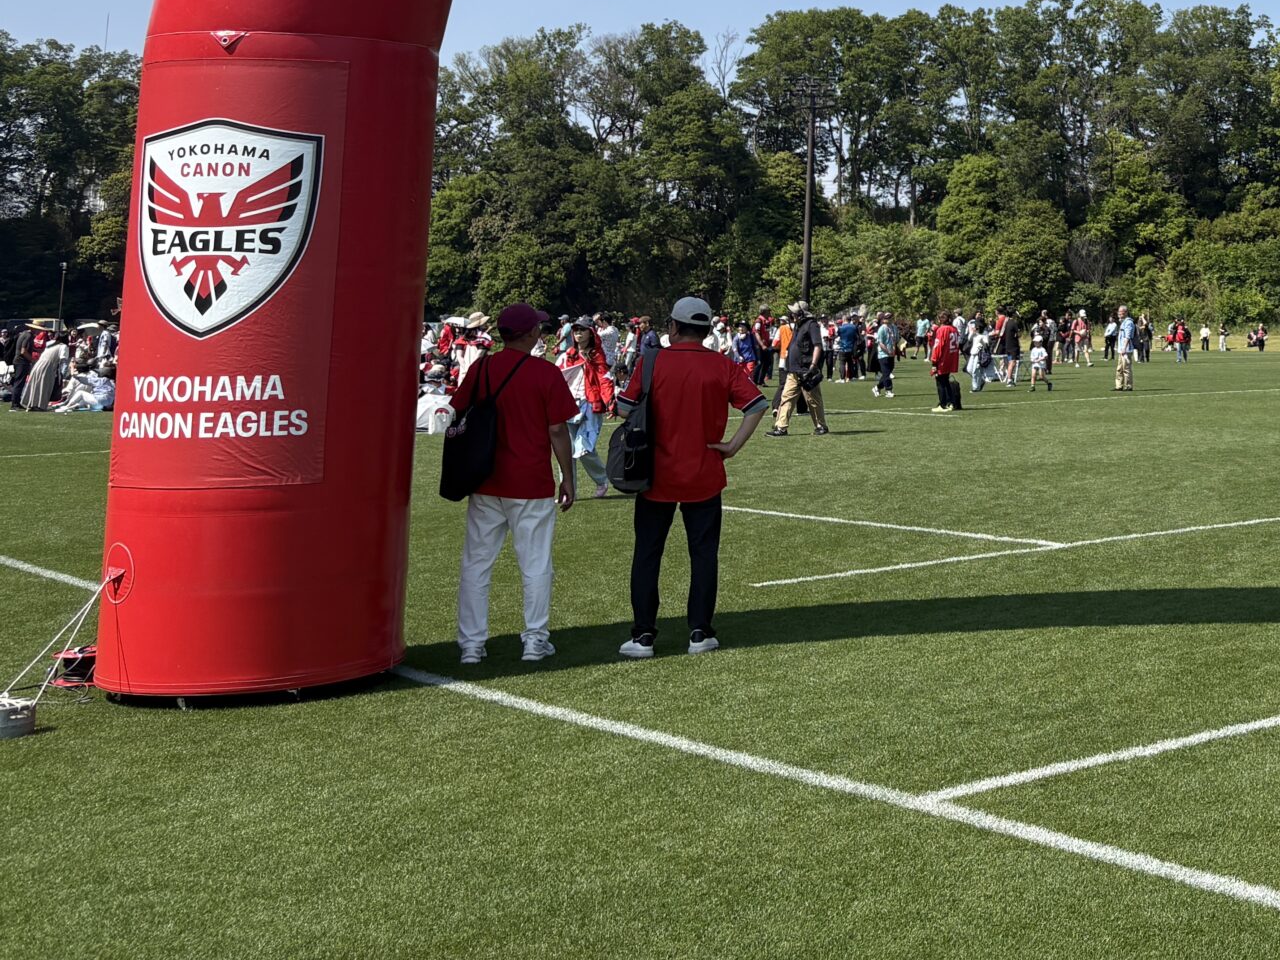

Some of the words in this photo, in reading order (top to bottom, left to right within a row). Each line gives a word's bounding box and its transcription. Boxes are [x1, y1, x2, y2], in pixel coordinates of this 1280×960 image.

[168, 143, 271, 161] YOKOHAMA
[180, 162, 250, 178] CANON
[151, 226, 288, 256] EAGLES
[133, 374, 285, 403] YOKOHAMA
[119, 412, 193, 439] CANON
[198, 409, 308, 438] EAGLES
